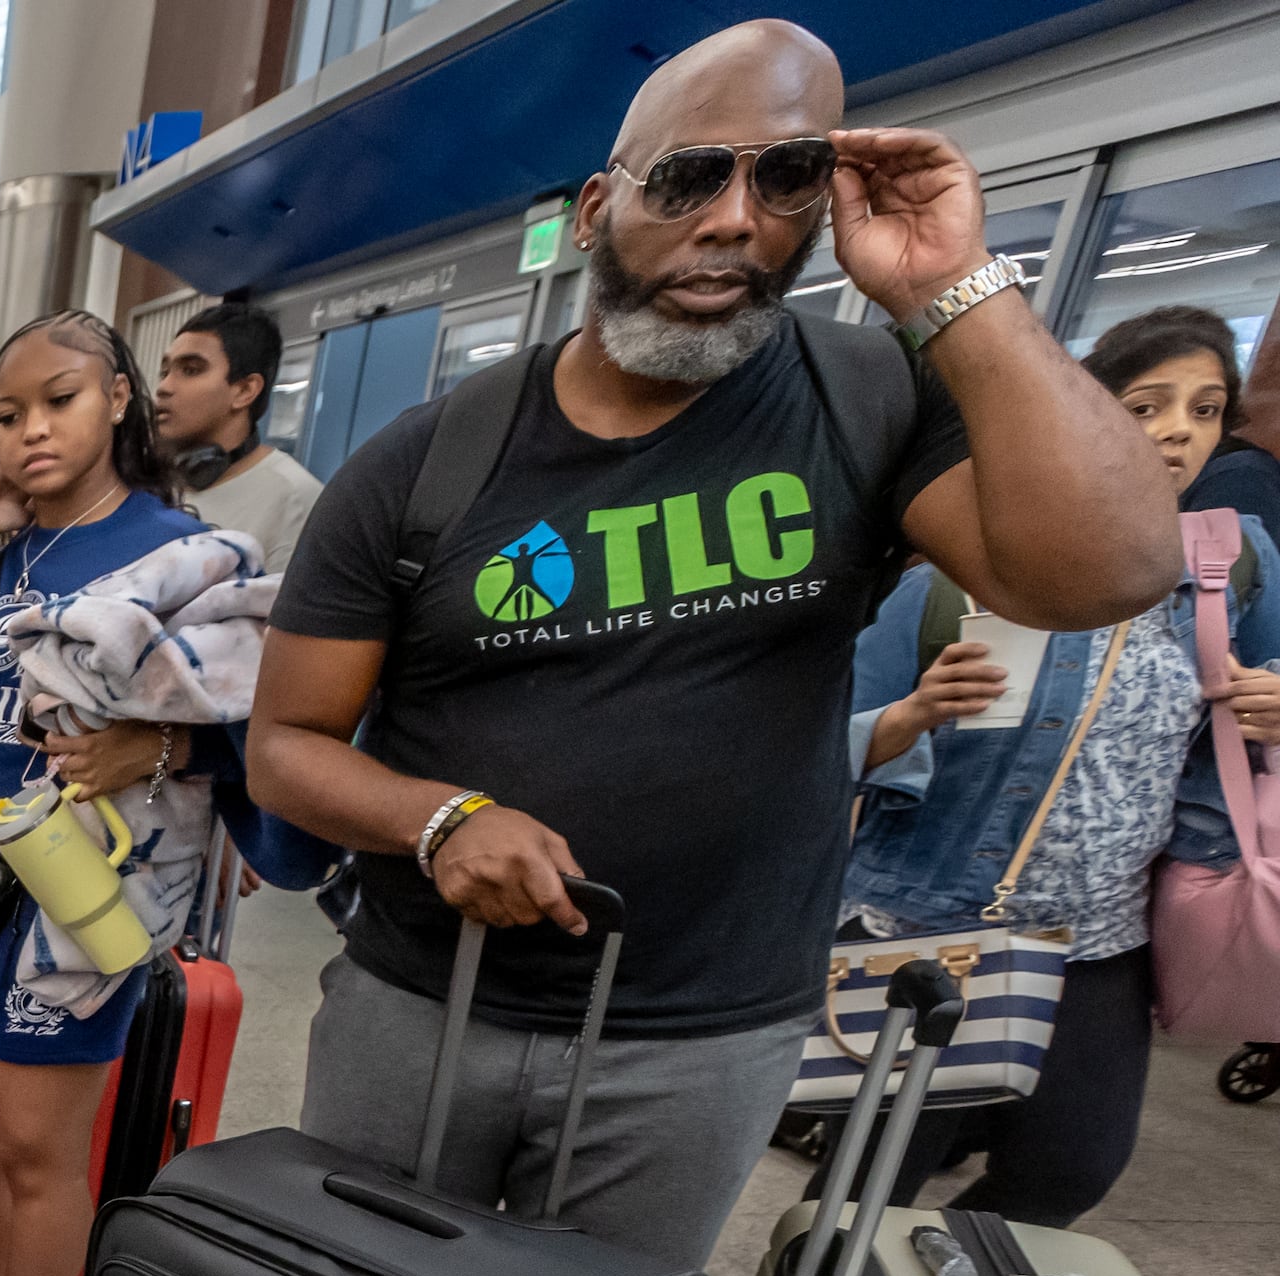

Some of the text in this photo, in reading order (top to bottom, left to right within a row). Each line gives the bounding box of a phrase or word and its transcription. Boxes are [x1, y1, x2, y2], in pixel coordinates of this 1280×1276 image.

[586, 471, 815, 610] TLC
[474, 624, 571, 650] TOTAL
[586, 610, 655, 635] LIFE
